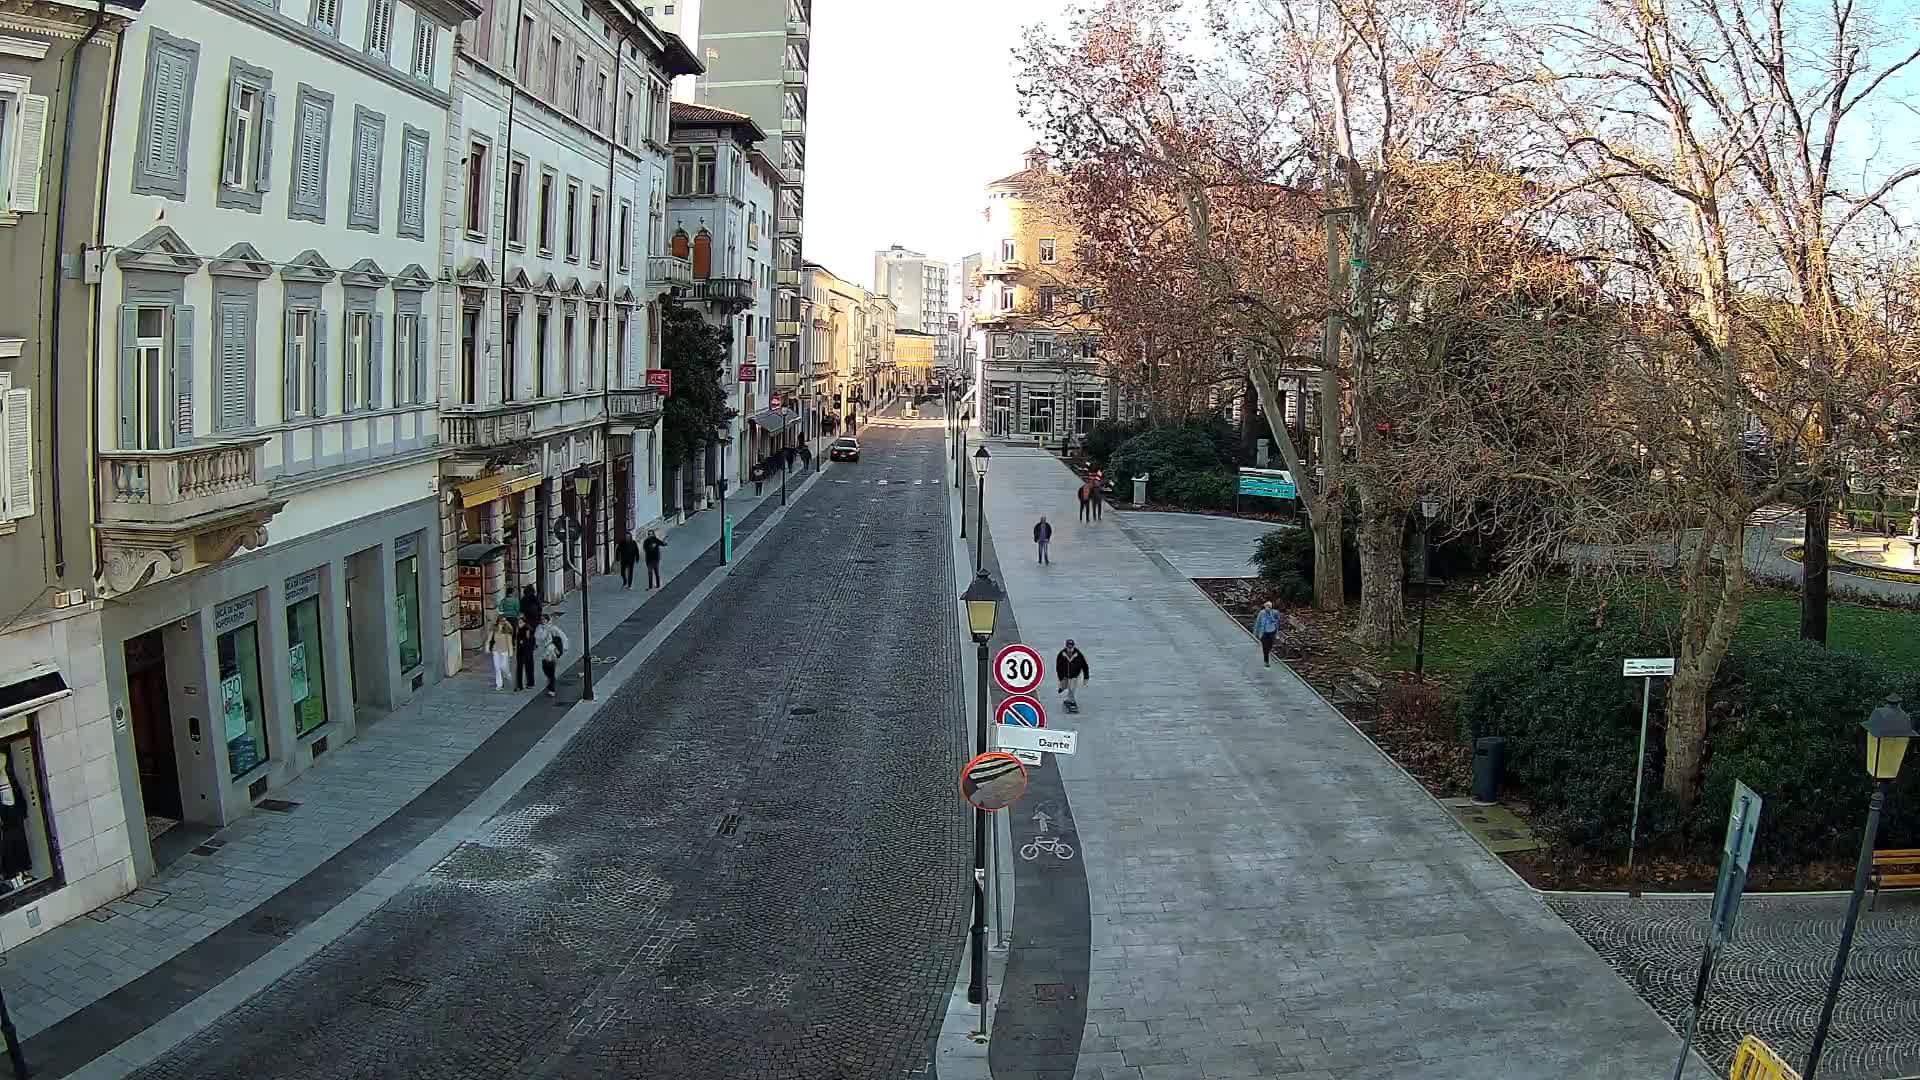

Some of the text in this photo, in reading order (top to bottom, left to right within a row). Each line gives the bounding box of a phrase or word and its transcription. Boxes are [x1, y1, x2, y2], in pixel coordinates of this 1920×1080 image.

[1006, 659, 1033, 680] 30
[222, 677, 241, 700] 130
[1039, 738, 1070, 749] Dante
